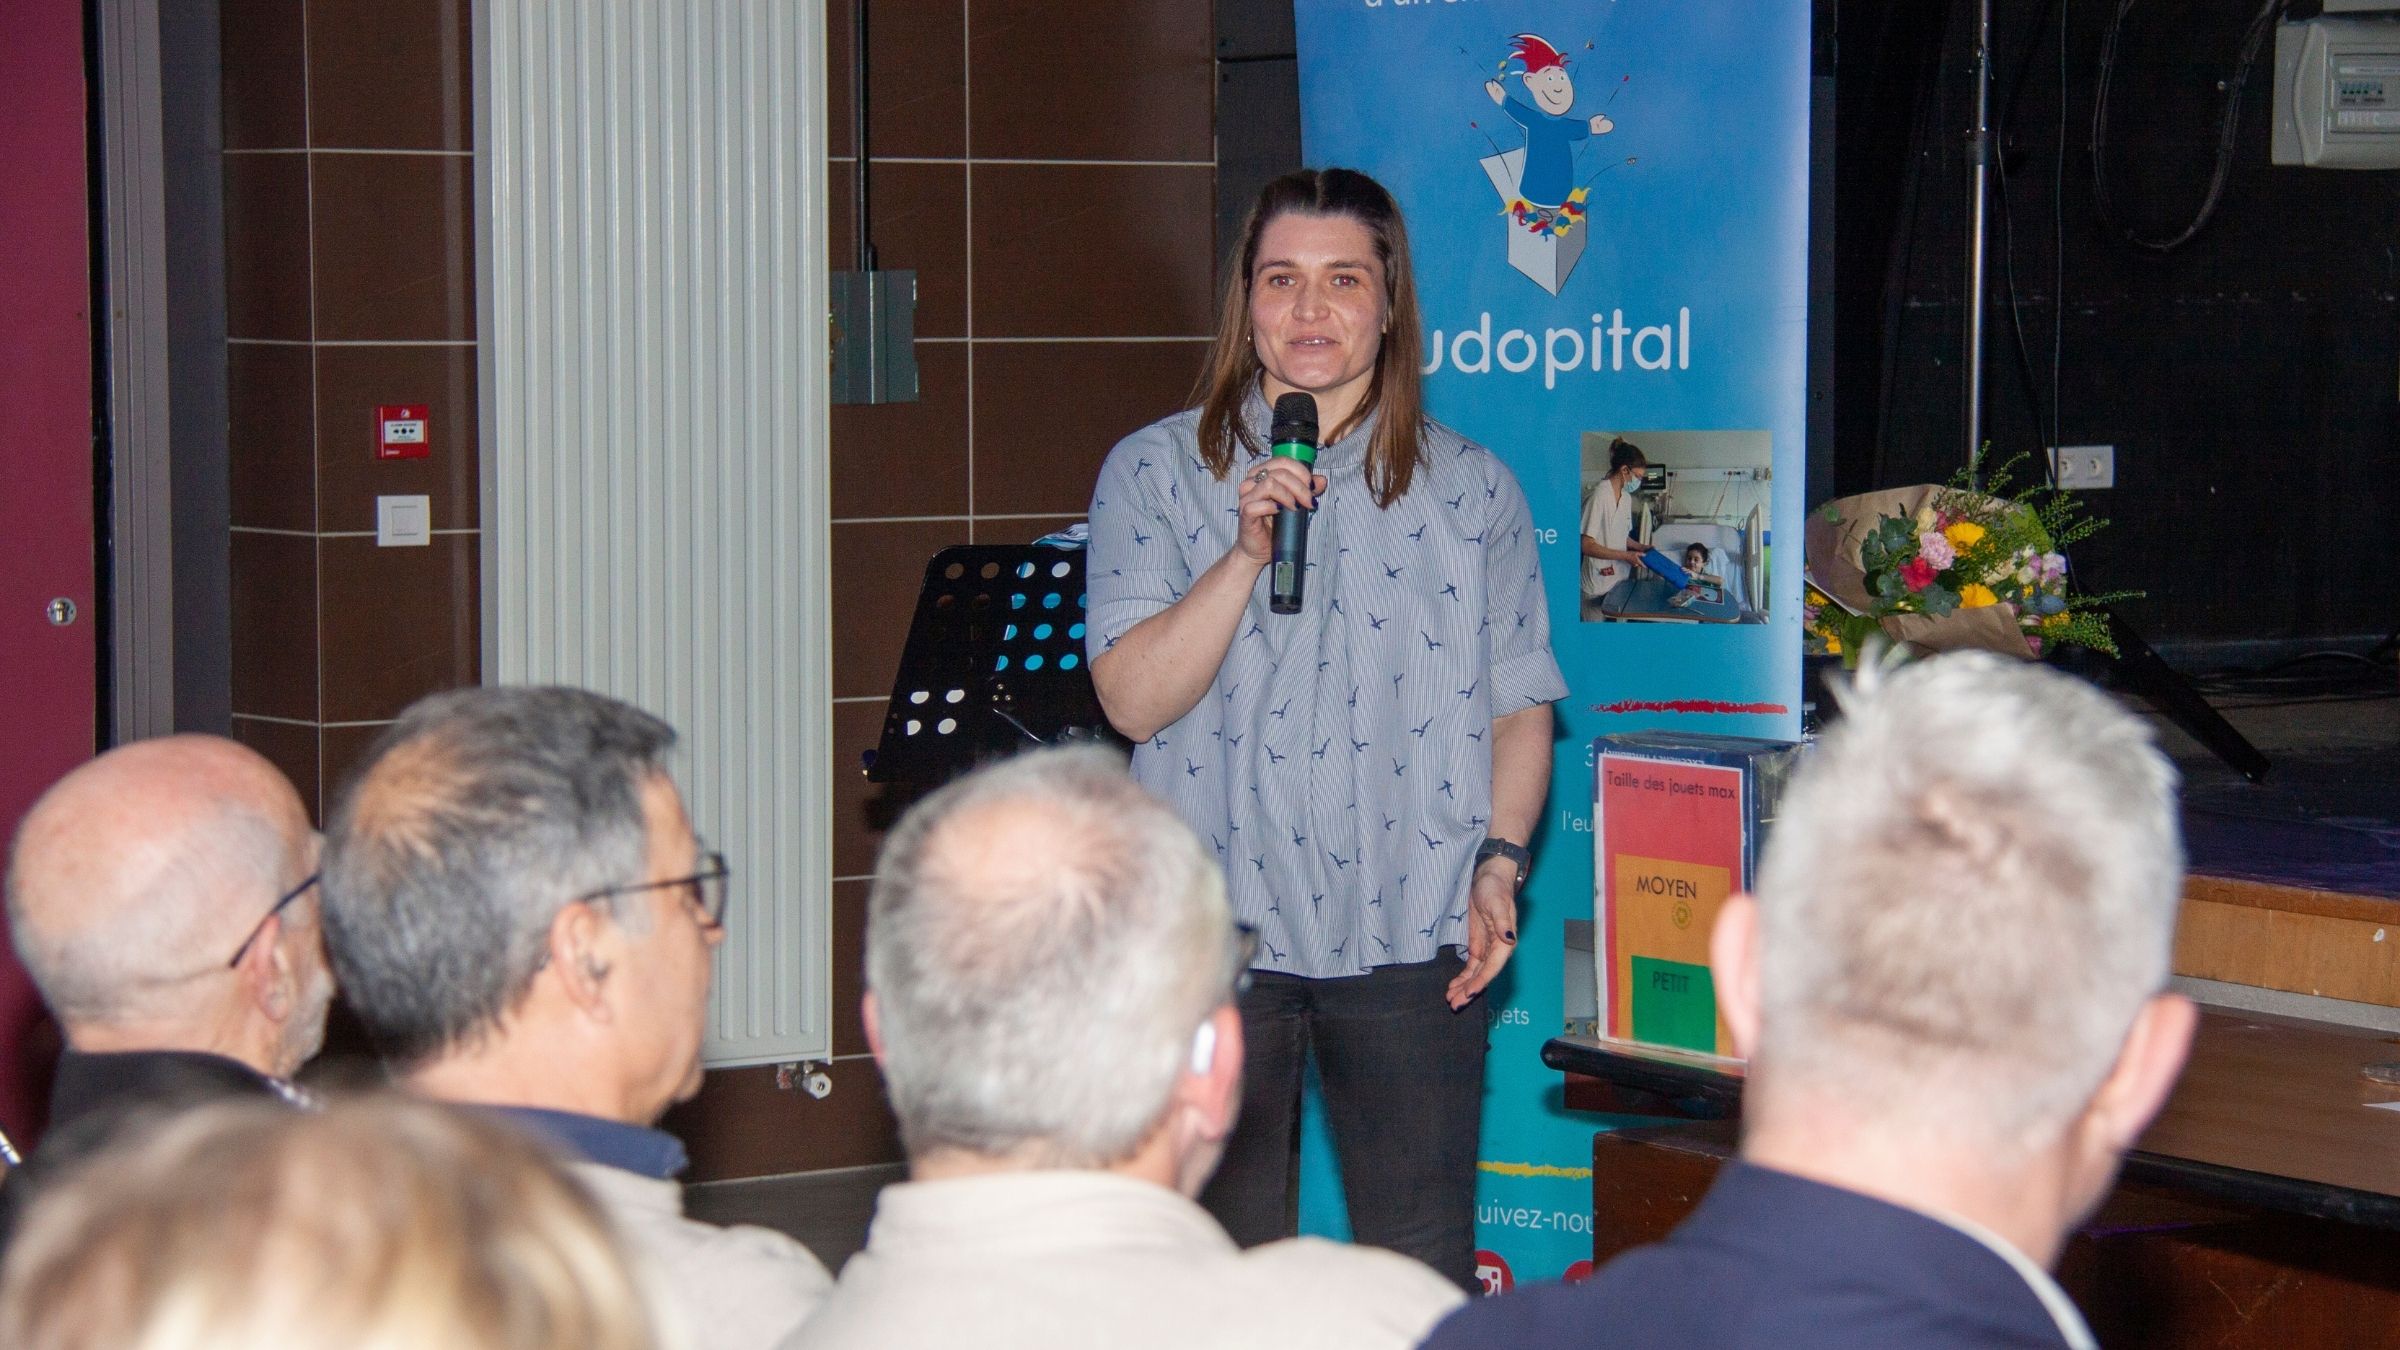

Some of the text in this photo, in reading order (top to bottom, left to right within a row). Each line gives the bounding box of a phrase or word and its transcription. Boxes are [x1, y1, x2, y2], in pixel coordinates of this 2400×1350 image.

[1606, 770, 1735, 799] Taille des jouets max
[1636, 876, 1697, 899] MOYEN
[1652, 970, 1689, 993] PETIT
